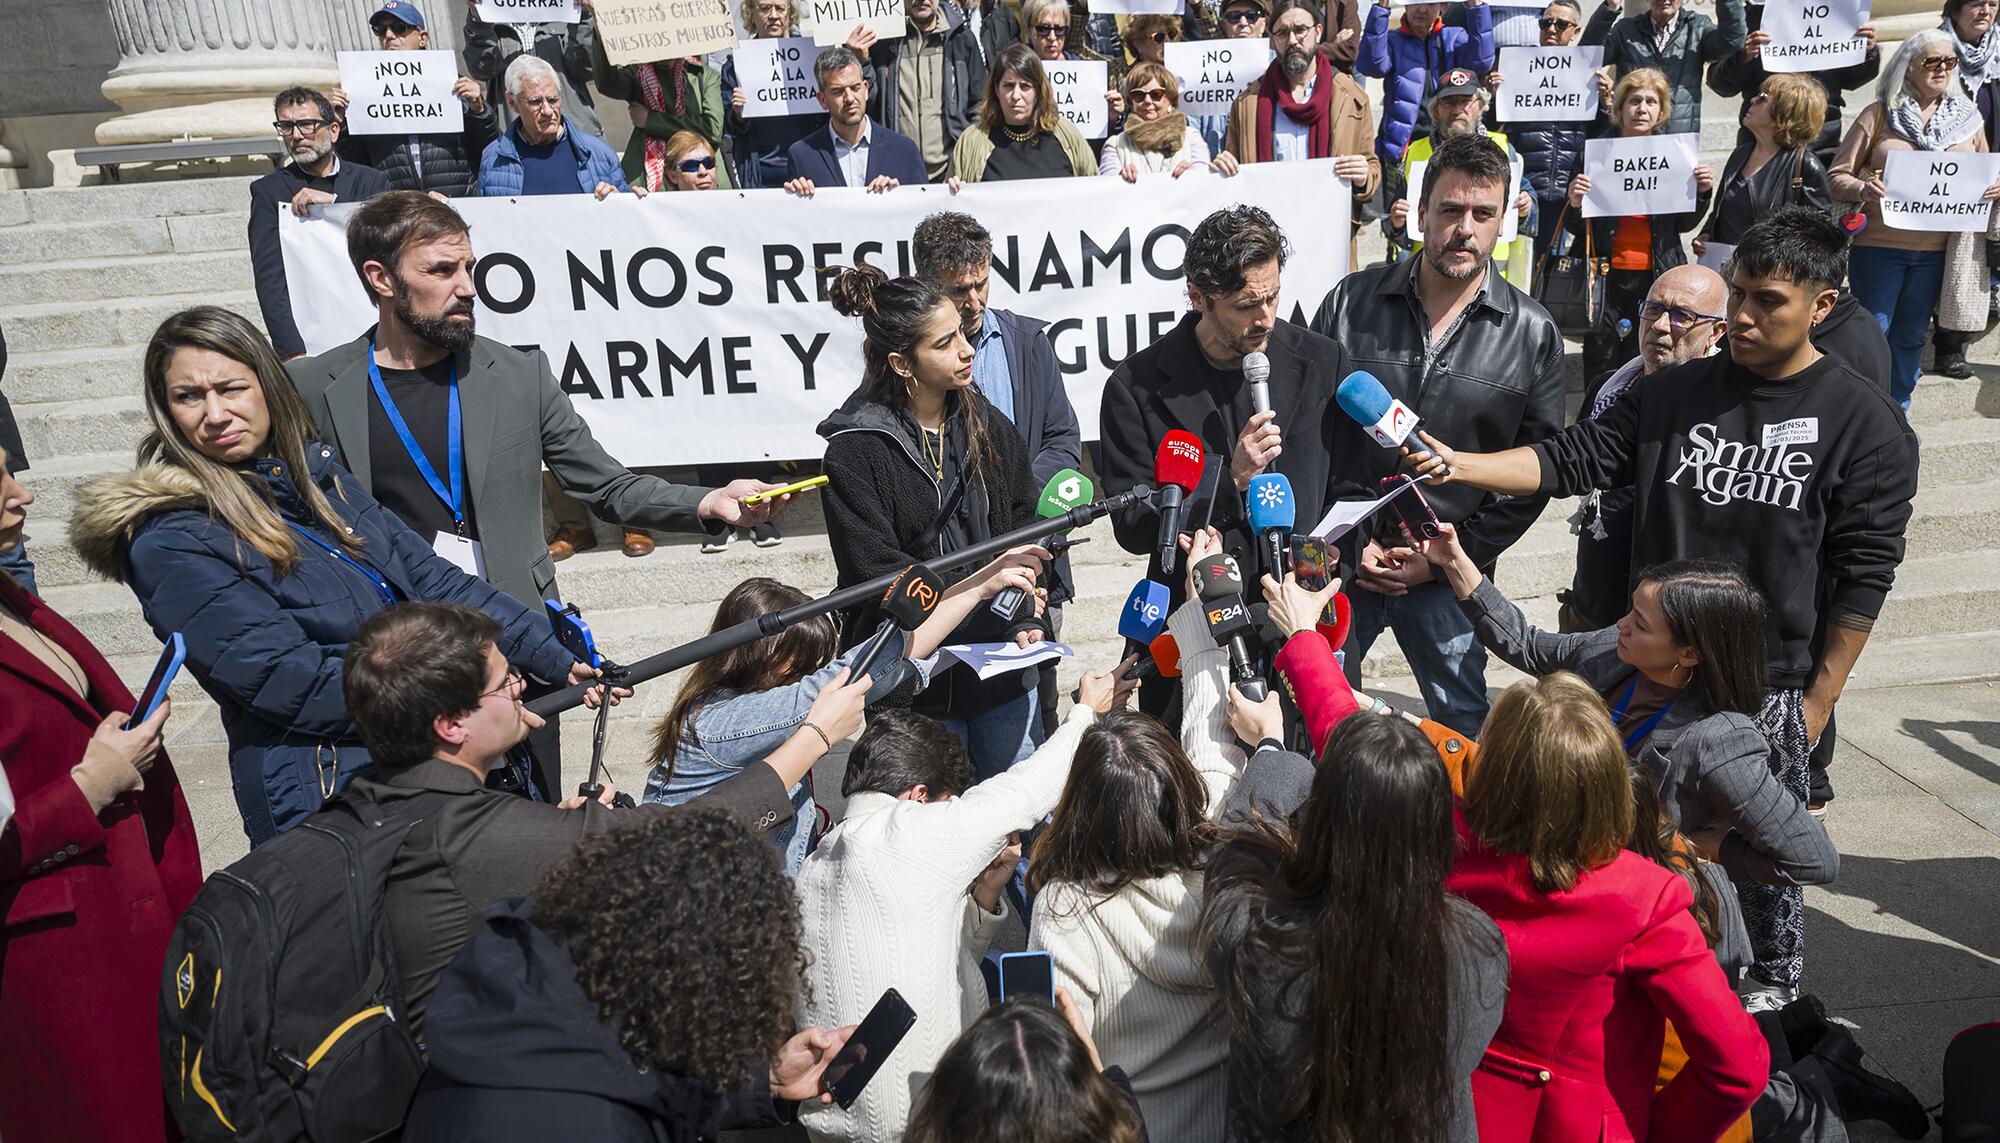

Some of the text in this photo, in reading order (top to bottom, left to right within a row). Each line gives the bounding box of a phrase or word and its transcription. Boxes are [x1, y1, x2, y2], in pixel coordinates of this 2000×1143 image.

[814, 0, 903, 24] MILITAR
[1802, 5, 1830, 20] NO
[1804, 24, 1823, 39] AL
[606, 31, 671, 52] NUESTROS
[1764, 39, 1864, 57] REARMAMENT!
[771, 47, 800, 66] ¡NO
[1202, 49, 1232, 68] ¡NO
[375, 61, 422, 80] ¡NON
[1529, 56, 1572, 74] ¡NON
[772, 67, 805, 82] A LA
[1200, 70, 1235, 84] A LA
[1539, 76, 1558, 89] AL
[383, 83, 422, 97] A LA
[1057, 91, 1075, 105] LA
[1183, 89, 1242, 103] GUERR
[1514, 94, 1581, 108] REARME!
[366, 103, 444, 119] GUERRA!
[1614, 156, 1670, 173] BAKEA
[1929, 162, 1959, 177] NO
[1623, 176, 1658, 192] BAI!
[1929, 181, 1950, 196] AL
[1884, 200, 1989, 216] REARMAMENT!
[474, 252, 536, 314] O
[566, 245, 734, 311] NOS
[780, 332, 831, 391] Y
[1770, 421, 1808, 434] PRENSA
[1167, 440, 1201, 454] europa
[1680, 423, 1814, 482] Smile
[1173, 448, 1200, 464] press
[1665, 447, 1804, 511] Again
[1224, 557, 1242, 582] 3
[1133, 596, 1160, 621] tve
